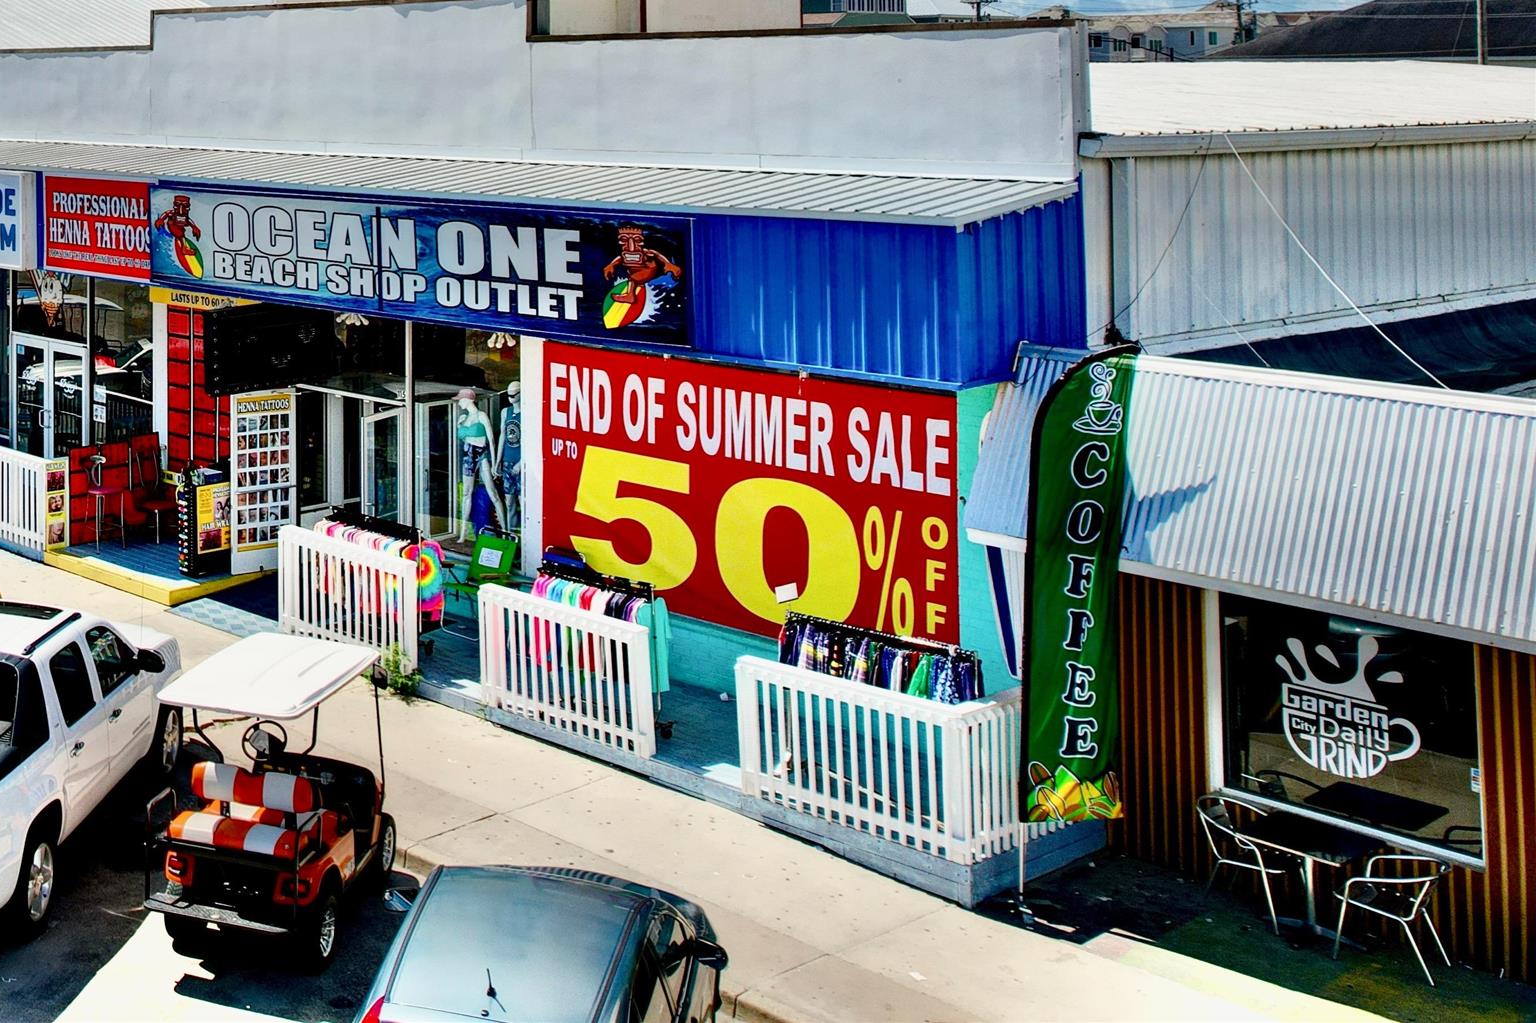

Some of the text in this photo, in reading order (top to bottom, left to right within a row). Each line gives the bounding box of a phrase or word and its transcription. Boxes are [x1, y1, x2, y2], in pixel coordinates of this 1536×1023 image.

[52, 192, 148, 220] PROFESSIONAL
[49, 217, 91, 246] HENNA
[212, 202, 583, 286] OCEAN ONE
[171, 292, 191, 303] LASTS
[191, 296, 199, 305] UP
[201, 296, 210, 306] TO
[213, 251, 583, 321] BEACH SHOP OUTLET
[237, 399, 290, 413] HENNA TATTOOS
[549, 361, 951, 496] END OF SUMMER SALE
[551, 438, 578, 459] UP TO
[921, 516, 948, 635] OFF
[1060, 441, 1110, 759] COFFEE
[1282, 683, 1389, 730] Garden
[1291, 716, 1390, 751] City Daily
